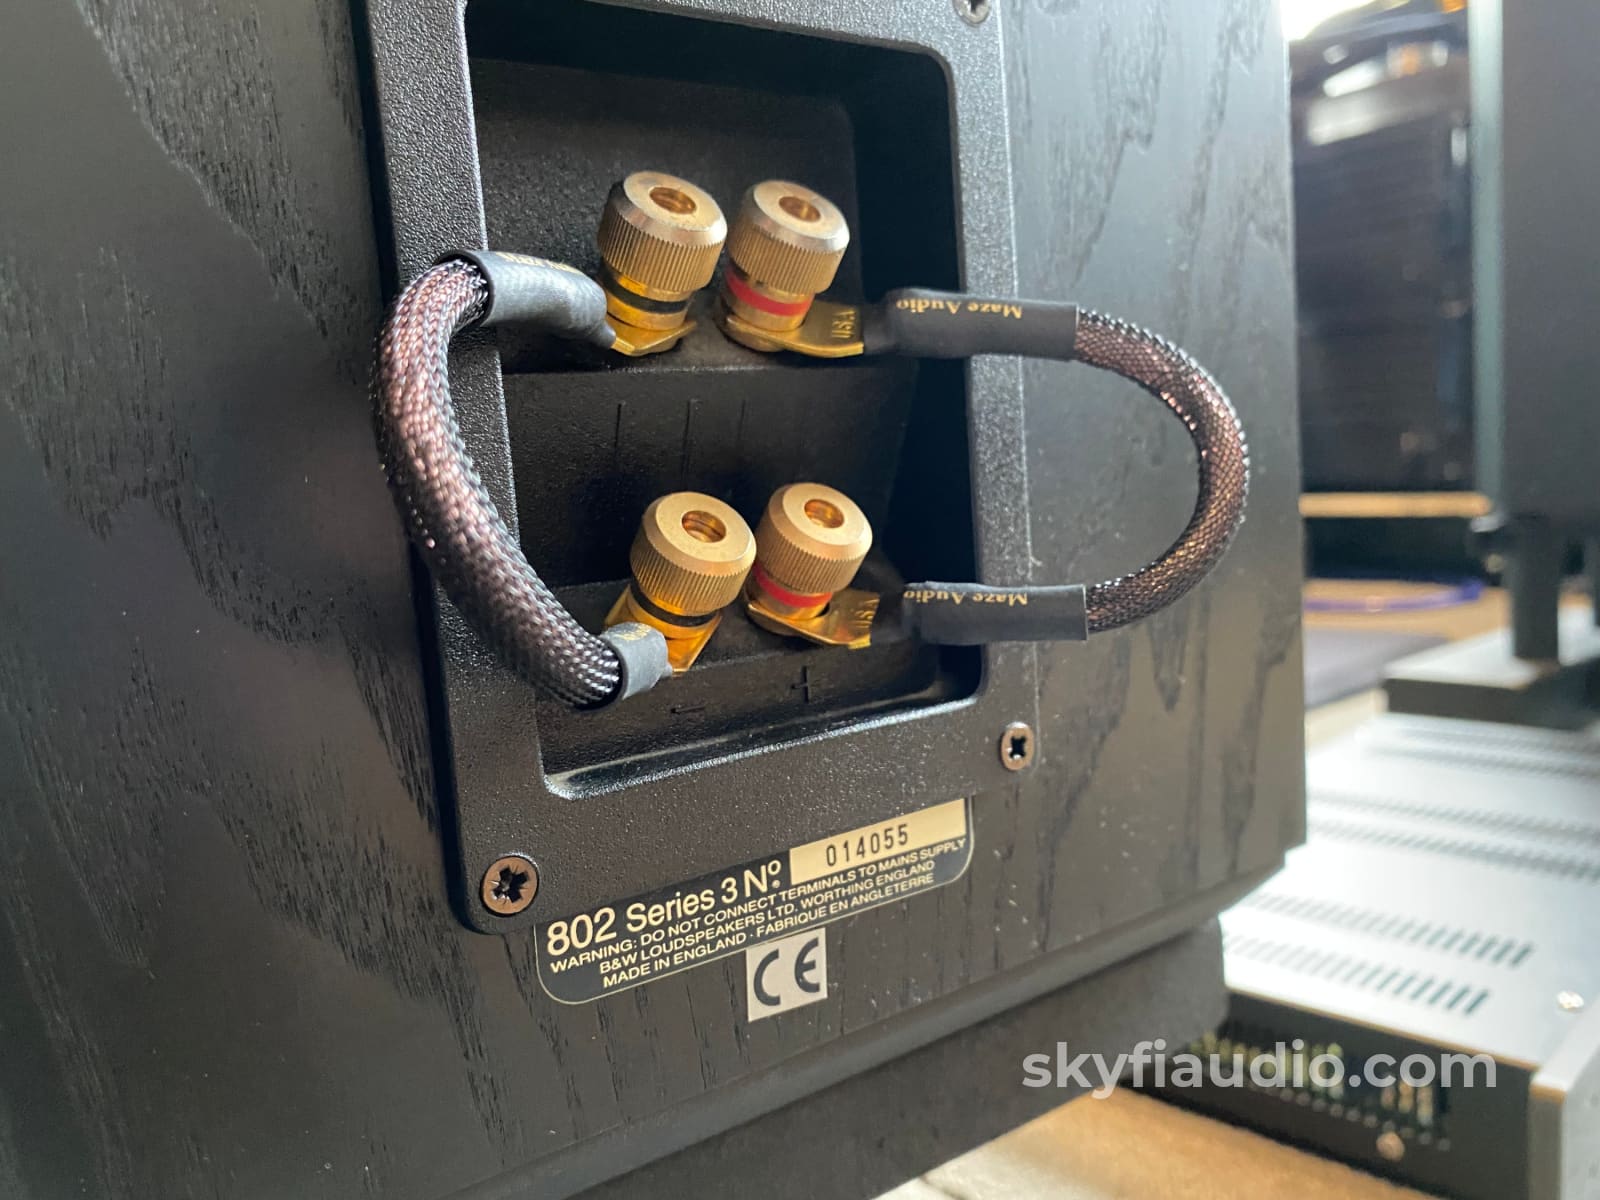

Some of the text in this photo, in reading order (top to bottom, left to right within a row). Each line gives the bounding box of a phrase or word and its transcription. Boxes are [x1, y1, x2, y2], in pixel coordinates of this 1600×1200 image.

[896, 298, 1022, 320] Maze Audio
[903, 590, 1028, 607] Maze Audio
[547, 907, 617, 956] 802
[626, 888, 715, 932] Series
[721, 877, 738, 904] 3
[826, 824, 908, 867] 014055
[550, 838, 966, 974] WARNING: DO NOT CONNECT TERMINALS TO MAINS SUPPLY
[600, 952, 638, 975] B&W
[641, 912, 765, 960] LOUDSPEAKERS
[801, 878, 874, 909] WORTHING
[876, 860, 935, 886] ENGLAND
[603, 873, 934, 988] MADE IN ENGLAND FABRIQUE EN ANGLETERRE
[753, 937, 821, 1006] CE
